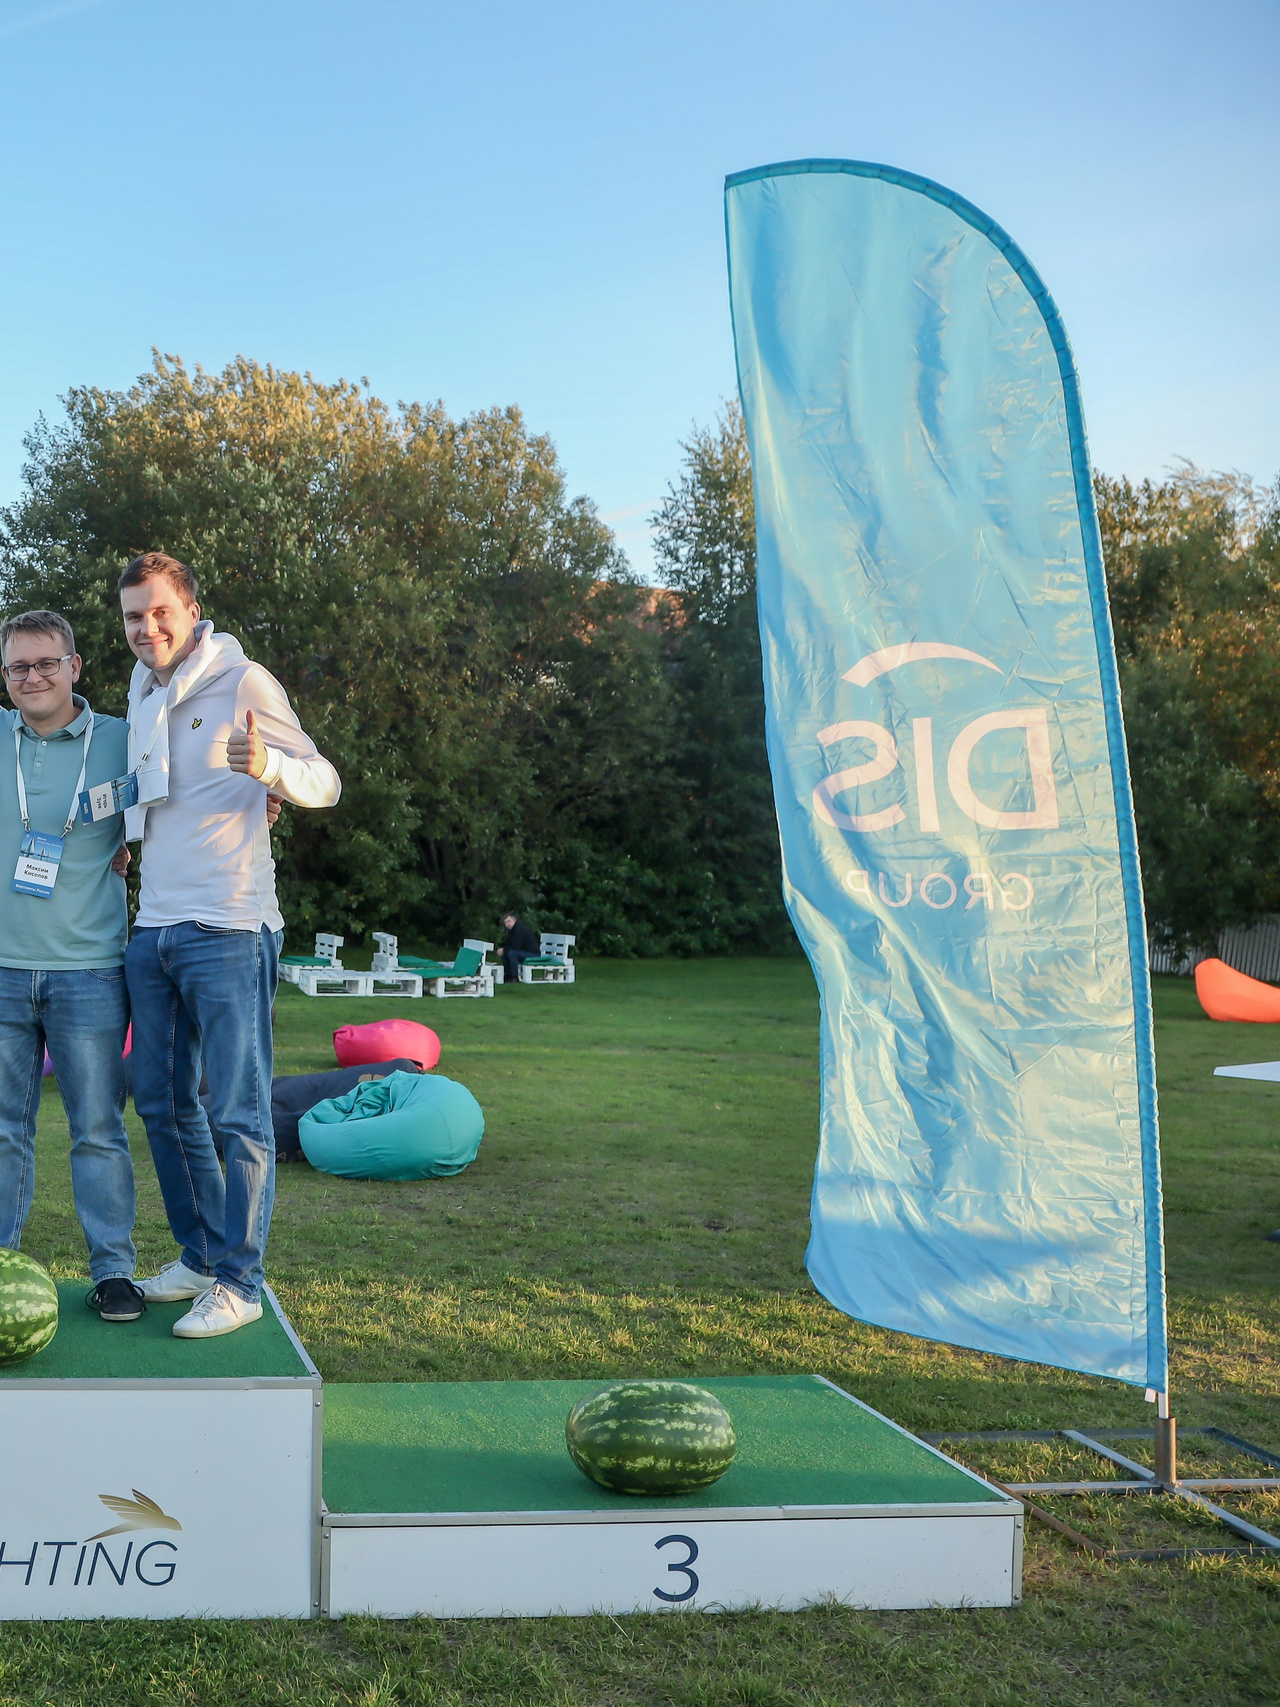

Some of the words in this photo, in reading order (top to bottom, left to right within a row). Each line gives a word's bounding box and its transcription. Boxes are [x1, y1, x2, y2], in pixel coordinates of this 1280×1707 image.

[26, 864, 49, 873] Максим
[24, 870, 48, 880] Киселев
[652, 1533, 700, 1603] 3
